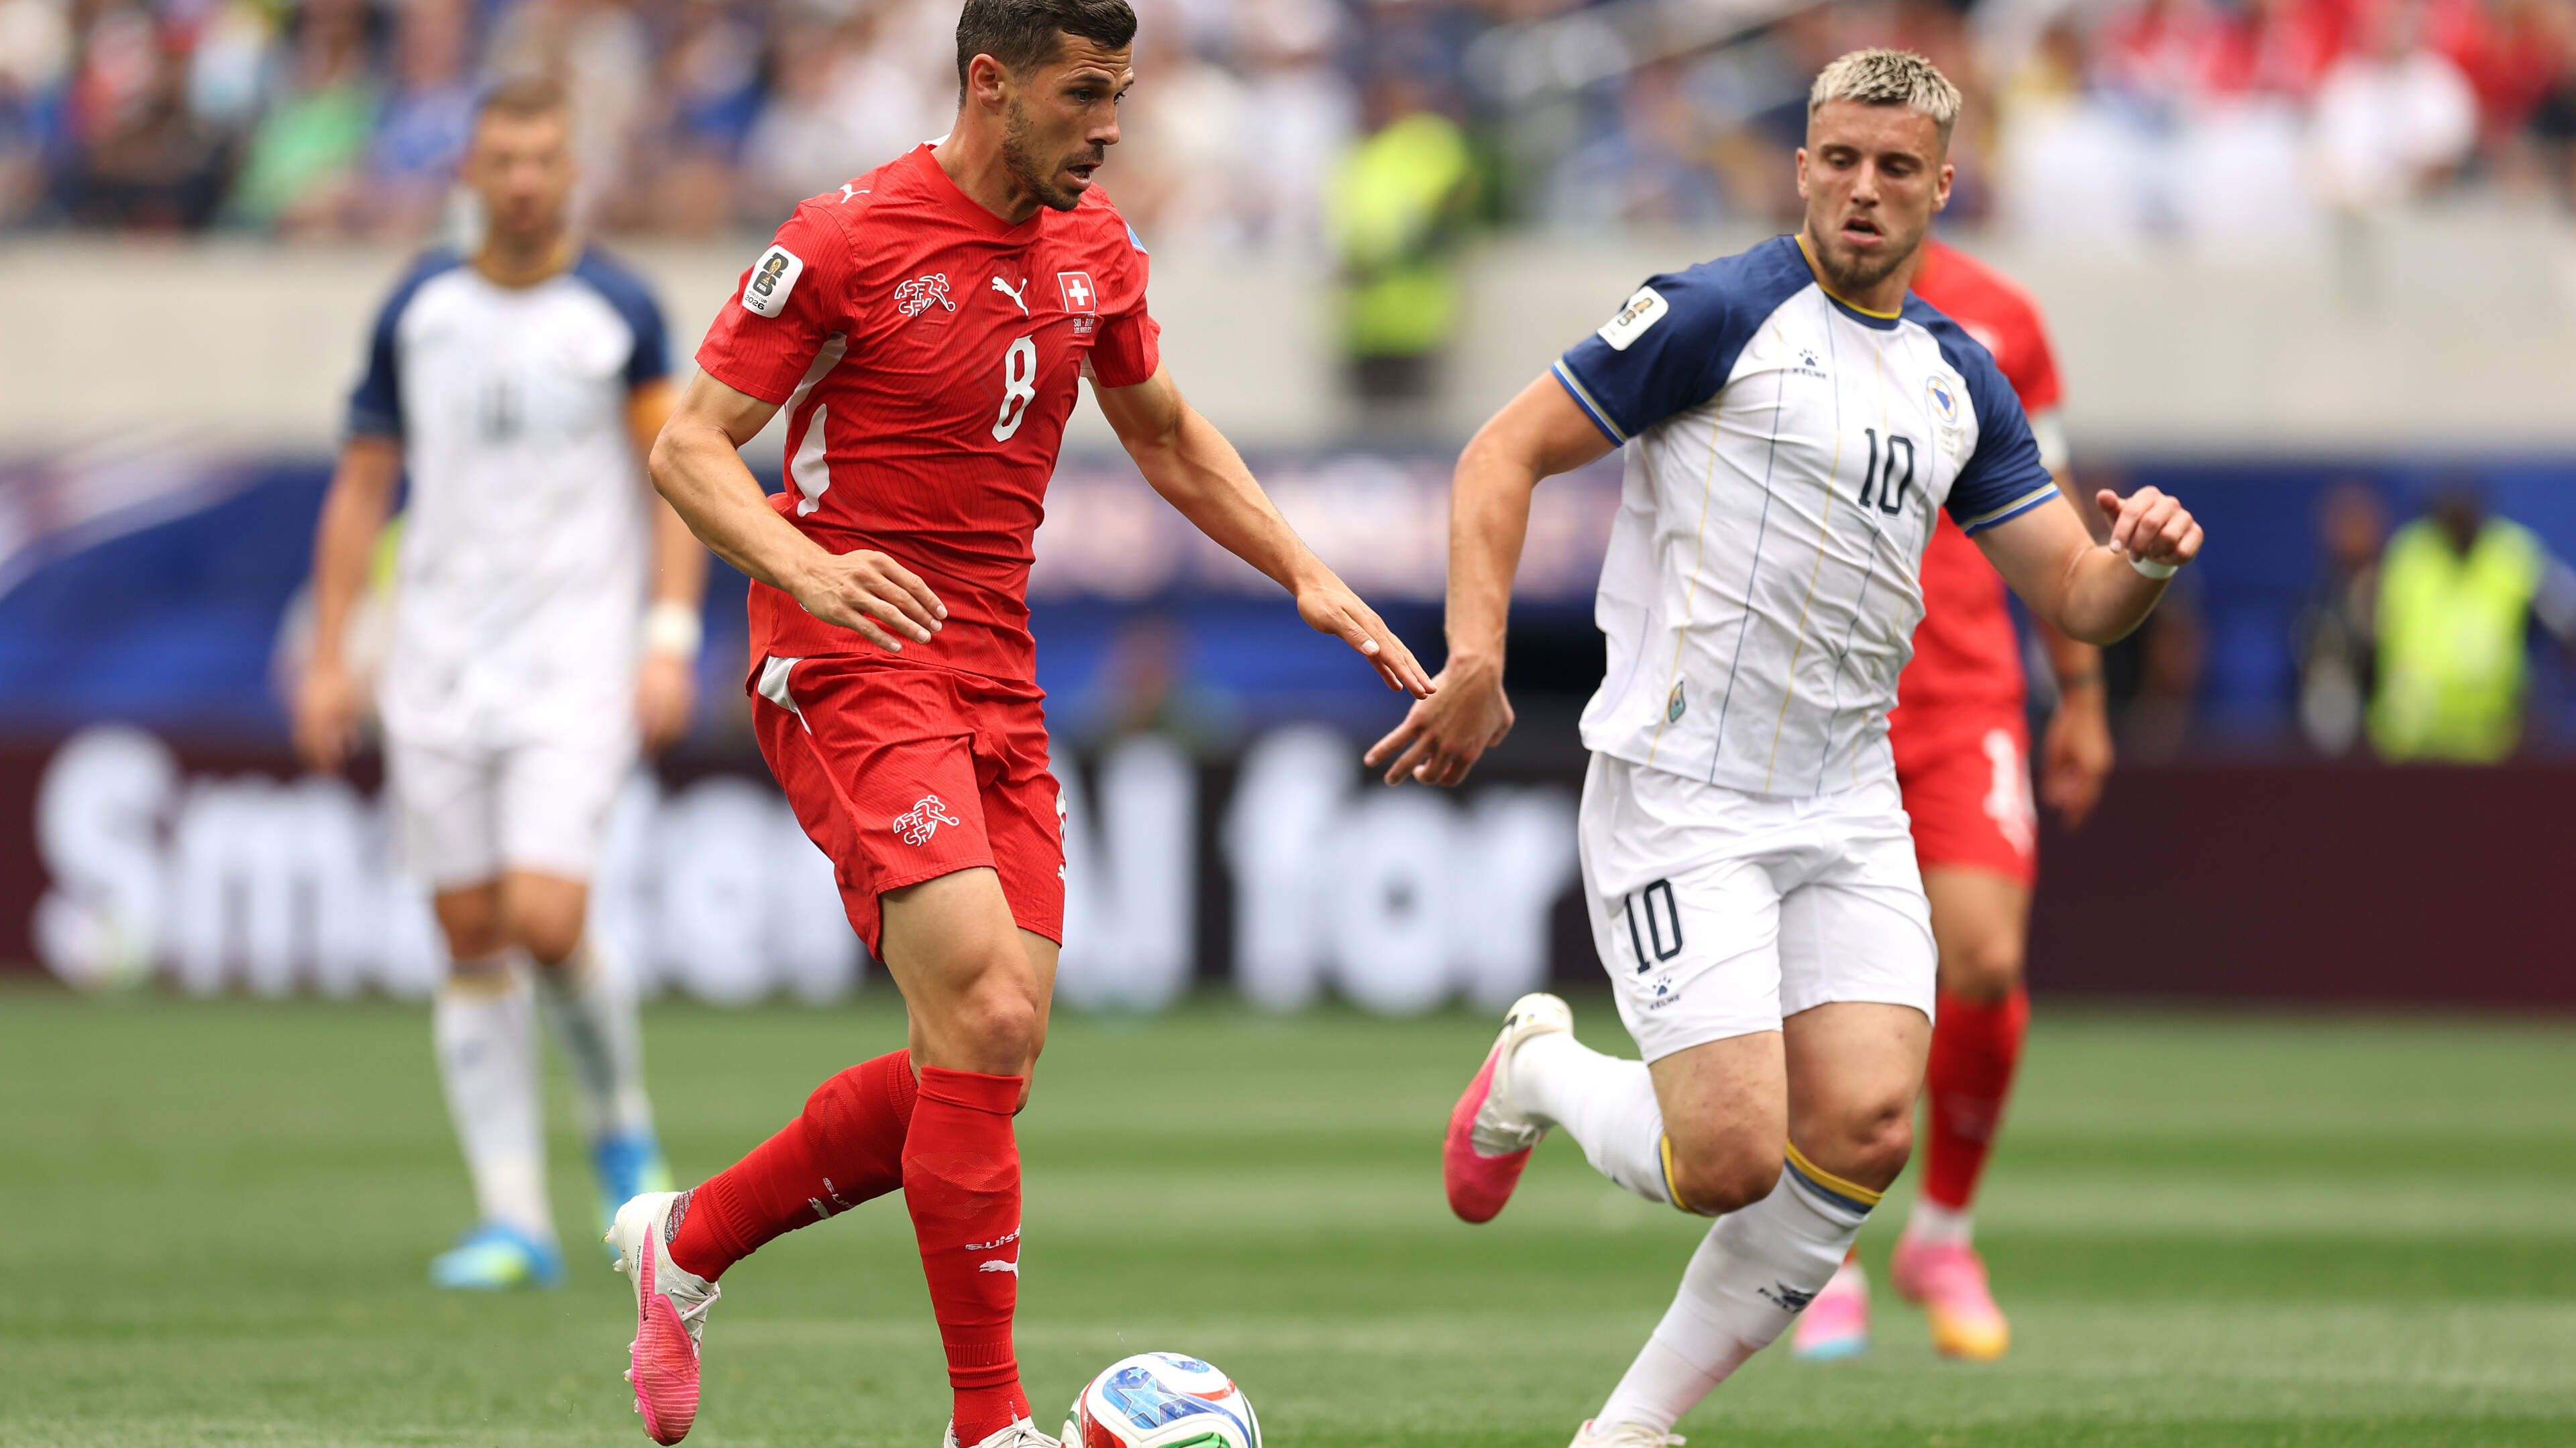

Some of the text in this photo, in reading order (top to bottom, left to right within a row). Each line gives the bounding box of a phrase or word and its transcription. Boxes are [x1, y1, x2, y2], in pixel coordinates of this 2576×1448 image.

[745, 294, 765, 310] 2026
[759, 296, 767, 304] CUP
[991, 334, 1037, 443] 8
[1858, 428, 1914, 514] 10
[1222, 724, 1578, 1014] for
[1625, 878, 1683, 974] 10
